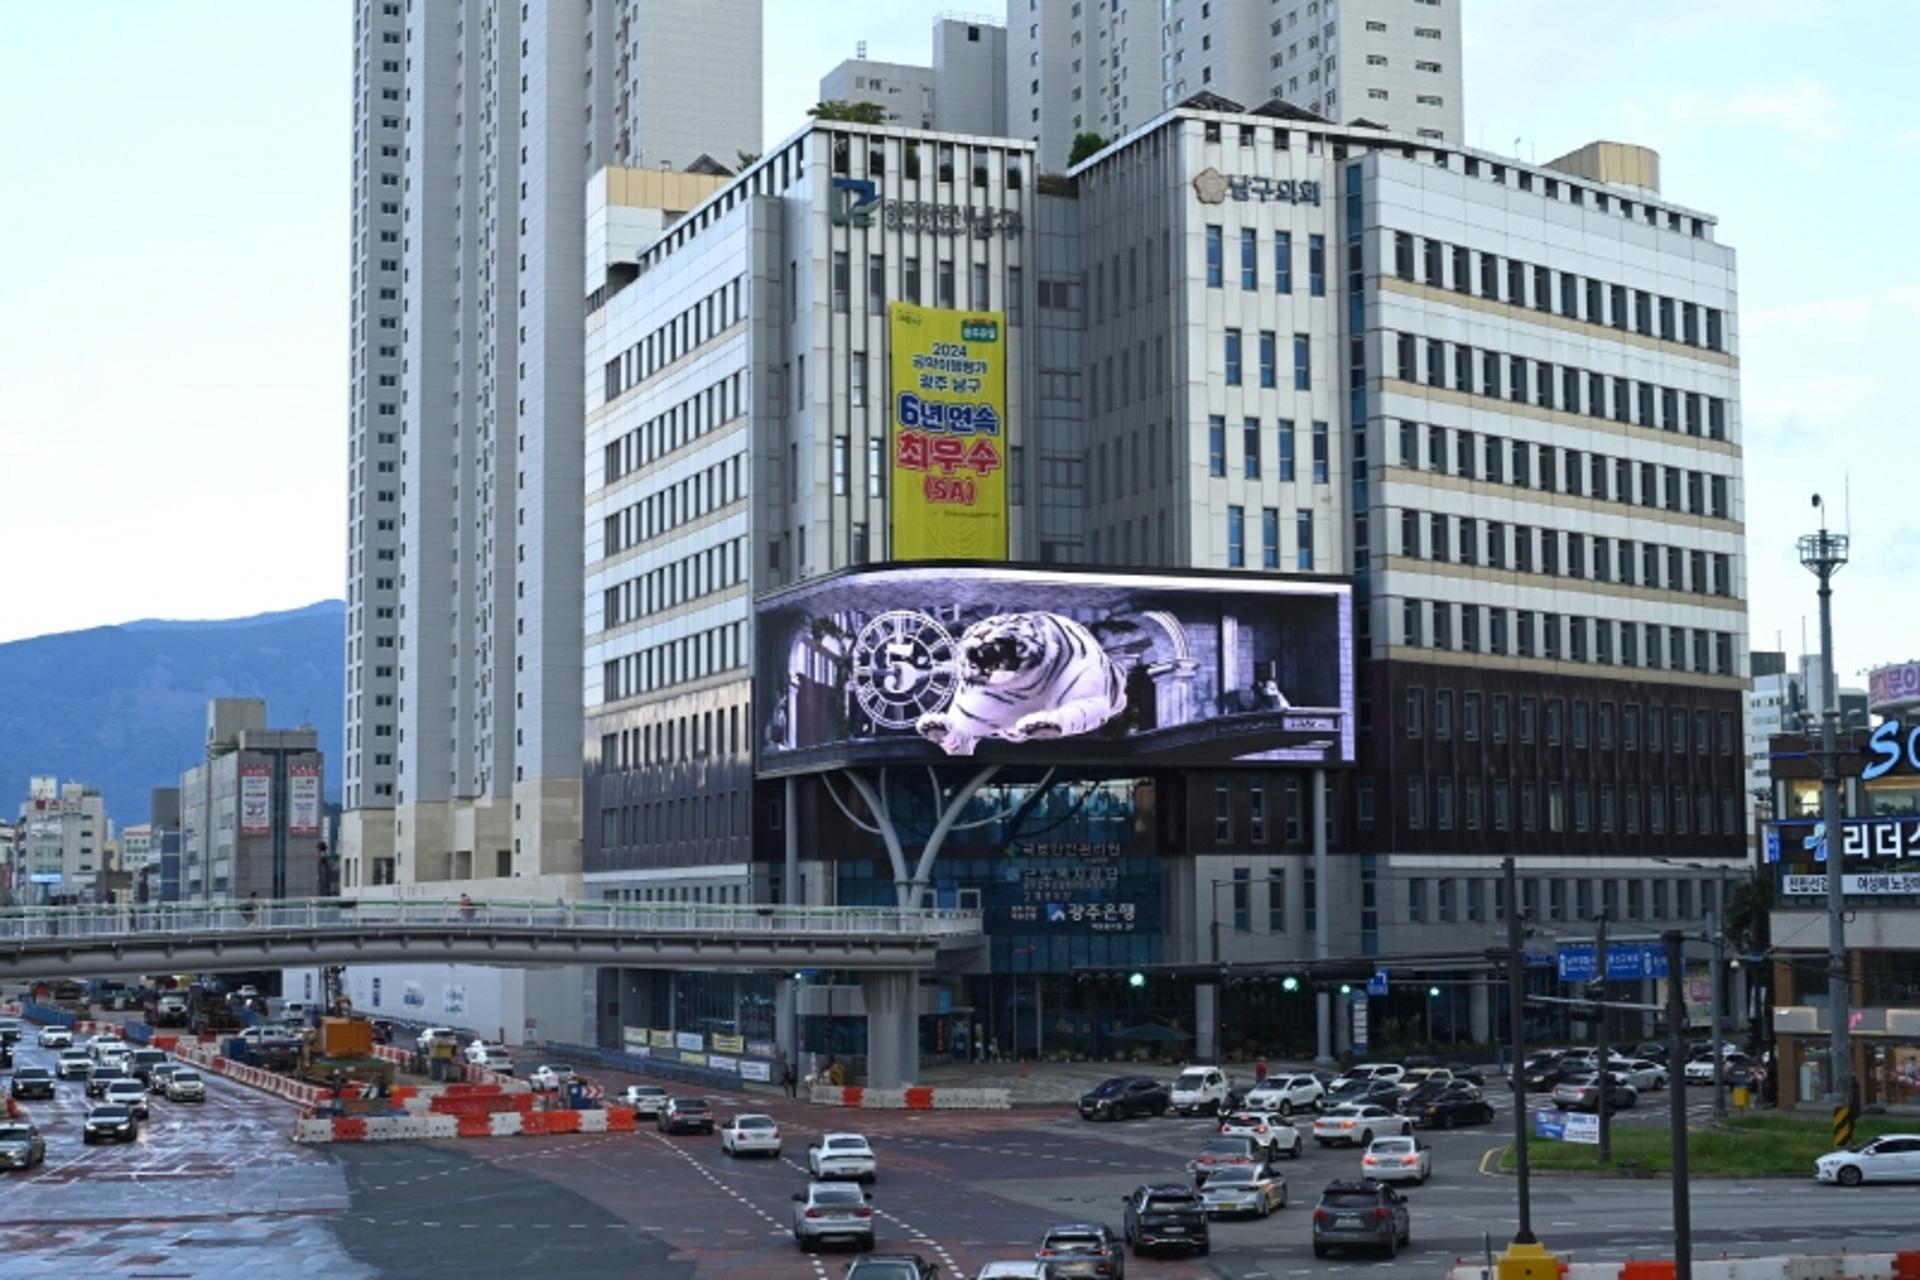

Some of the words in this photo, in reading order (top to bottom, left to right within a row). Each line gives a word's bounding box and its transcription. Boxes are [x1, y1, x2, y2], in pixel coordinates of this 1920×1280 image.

[1227, 174, 1320, 207] 남구의회
[932, 342, 967, 357] 2024
[920, 374, 948, 391] 광주
[953, 378, 981, 394] 남구
[898, 432, 1000, 475] 최우수
[924, 475, 975, 506] (SA)
[1068, 902, 1136, 922] 광주은행
